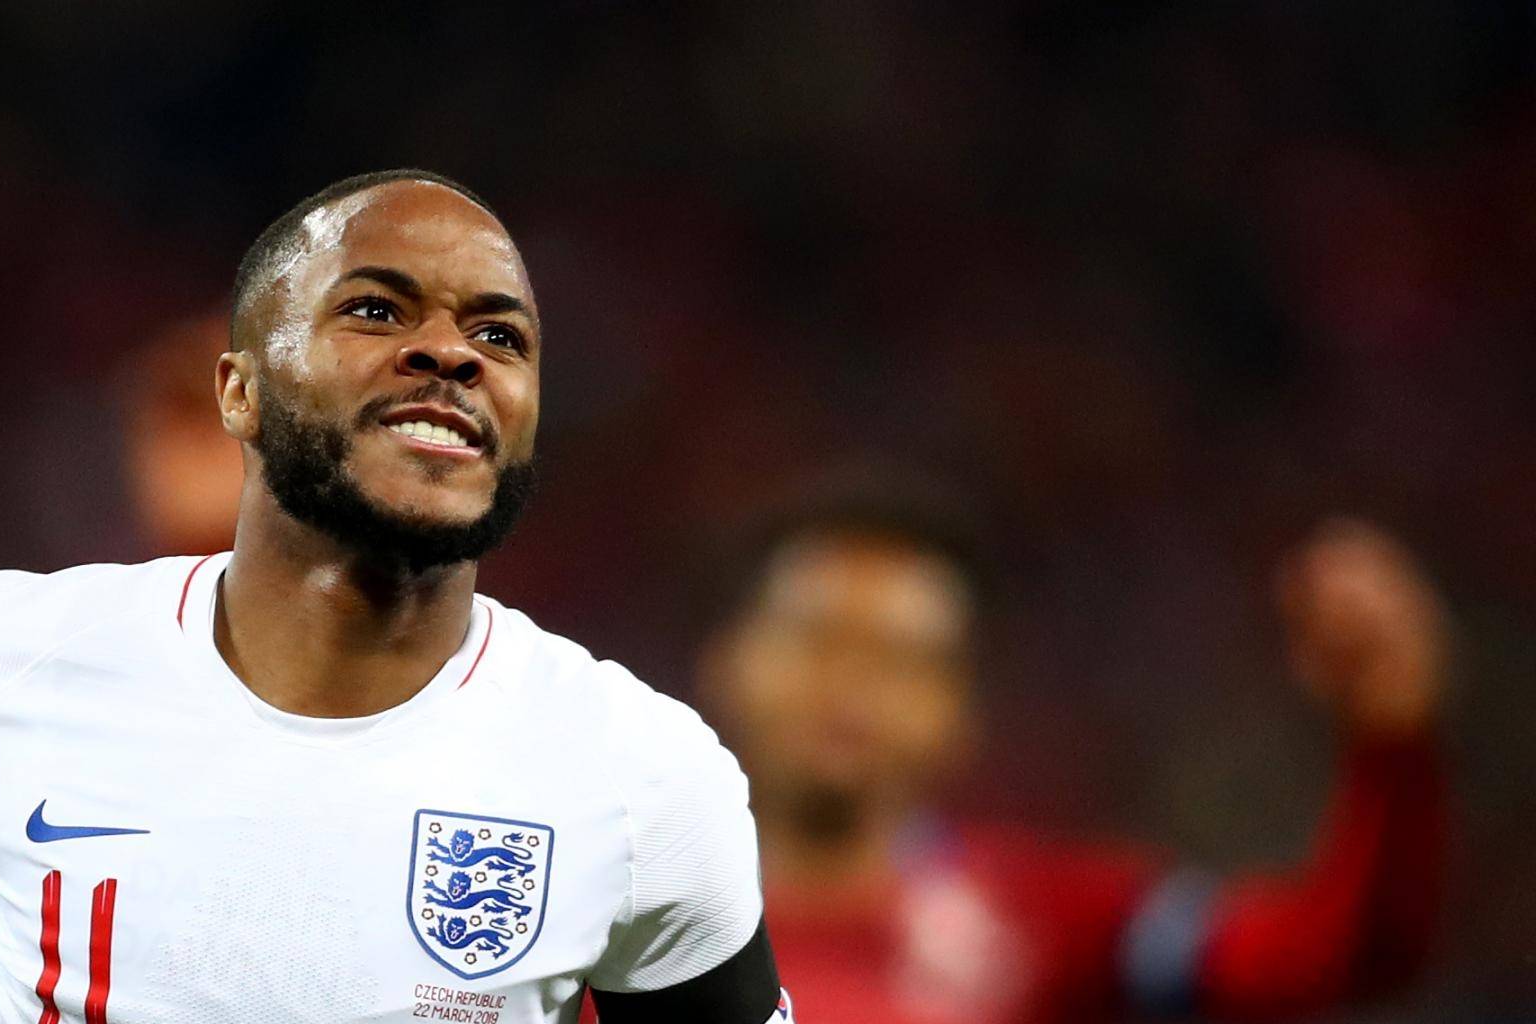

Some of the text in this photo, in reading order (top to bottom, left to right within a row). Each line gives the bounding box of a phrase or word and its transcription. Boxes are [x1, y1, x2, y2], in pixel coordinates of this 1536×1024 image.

[414, 984, 506, 1008] CZECH REPUBLIC
[413, 1002, 499, 1024] 22 MARCH 2019
